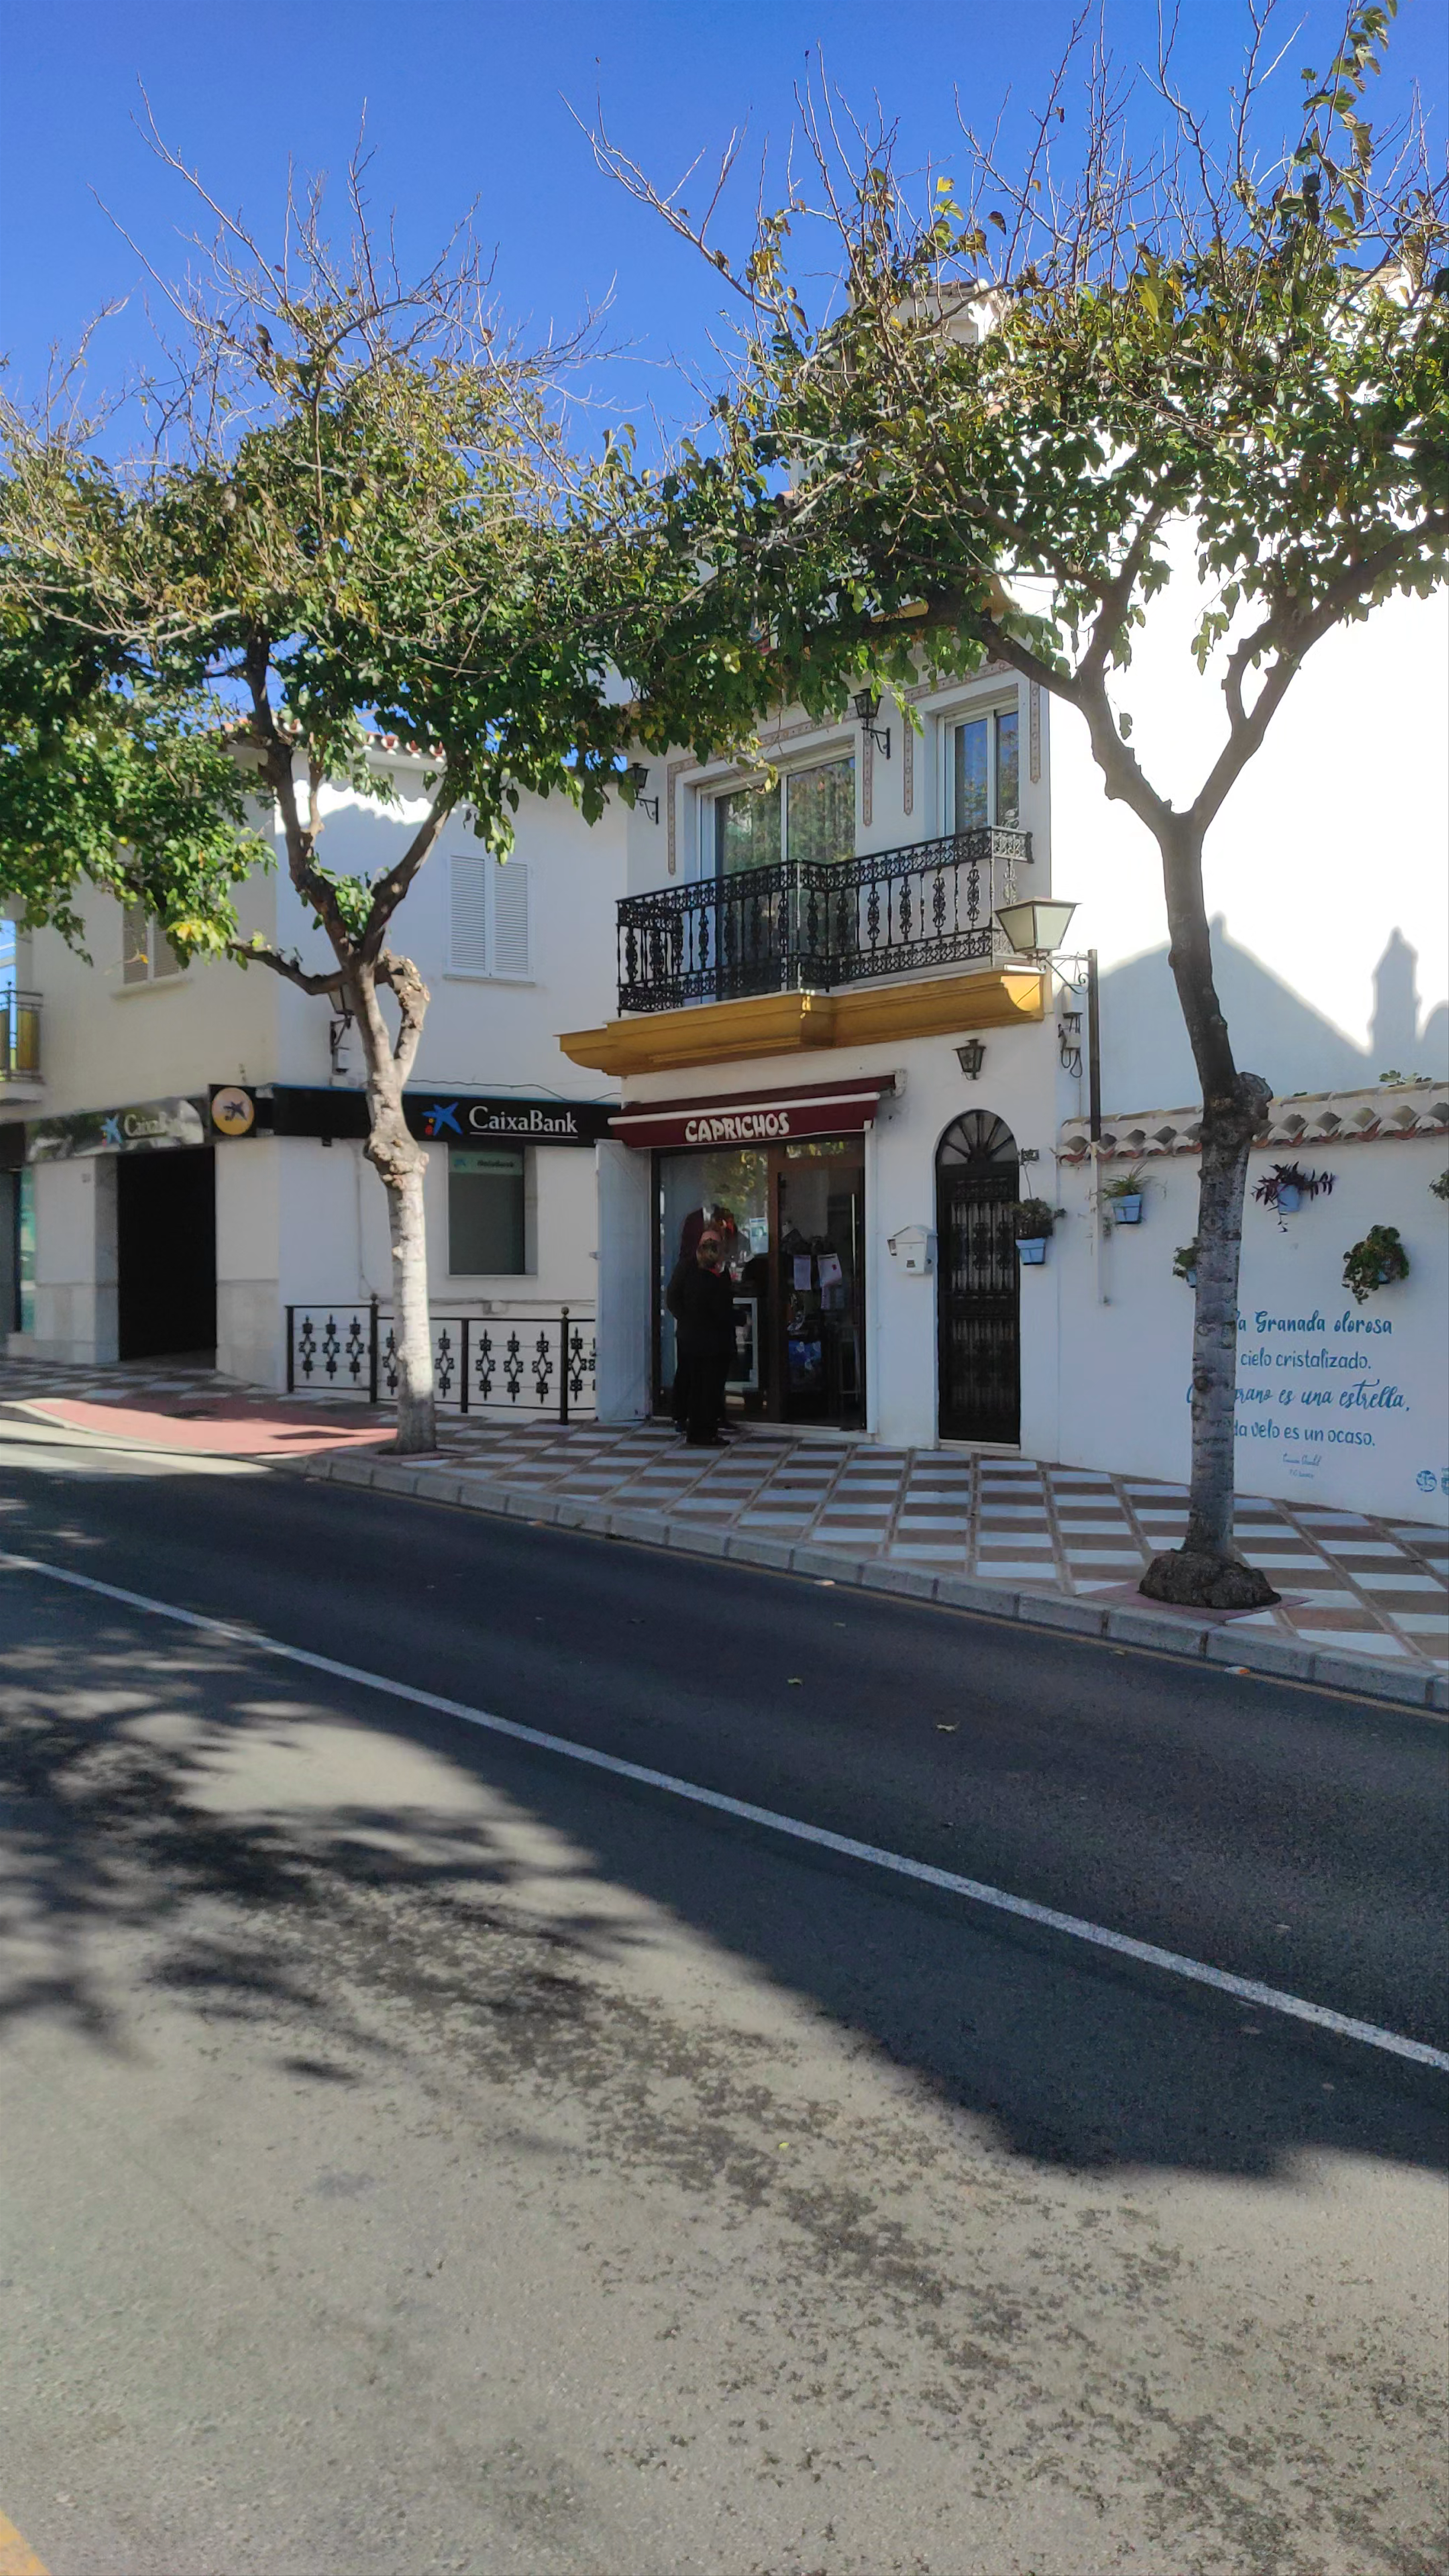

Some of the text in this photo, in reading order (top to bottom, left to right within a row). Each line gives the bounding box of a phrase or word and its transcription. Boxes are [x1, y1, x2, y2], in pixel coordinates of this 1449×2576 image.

[469, 1106, 578, 1133] CaixaBank
[685, 1112, 789, 1142] CAPRICHOS
[1255, 1310, 1325, 1333] Granada
[1334, 1310, 1392, 1334] olorosa
[1240, 1347, 1371, 1369] cielo cristalizado.
[1235, 1388, 1273, 1404] rano
[1278, 1389, 1295, 1406] es
[1301, 1390, 1333, 1406] una
[1251, 1418, 1280, 1439] velo
[1284, 1426, 1299, 1439] es
[1304, 1429, 1323, 1441] un
[1327, 1429, 1375, 1446] ocaso.
